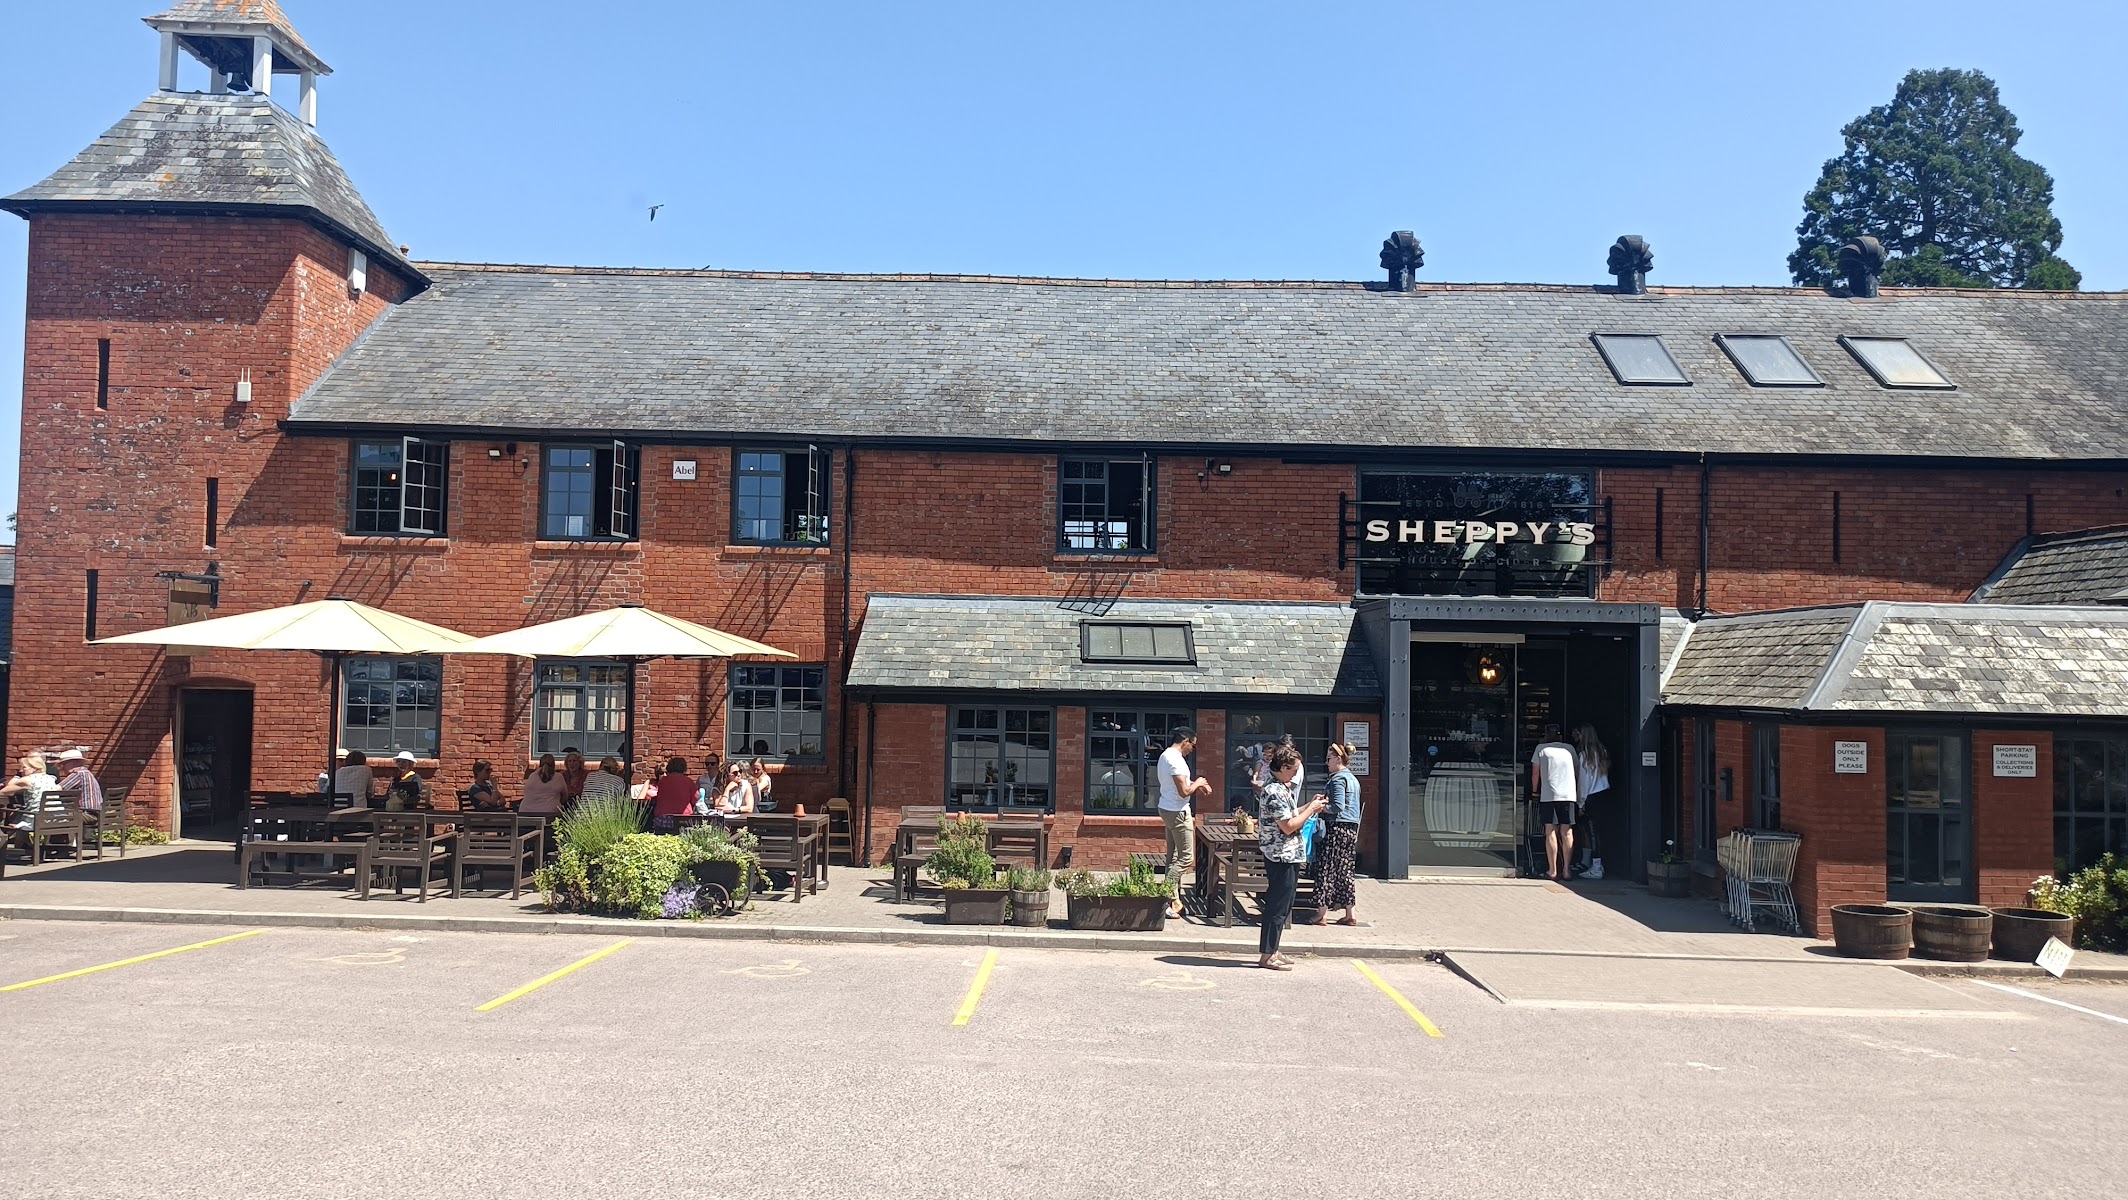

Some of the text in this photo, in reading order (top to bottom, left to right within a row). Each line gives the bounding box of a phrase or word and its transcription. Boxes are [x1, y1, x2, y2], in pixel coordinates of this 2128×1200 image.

[675, 466, 694, 475] Abel
[1365, 519, 1596, 546] SHEPPY'S
[1407, 555, 1458, 565] HOUSE
[1496, 558, 1541, 567] CIDER
